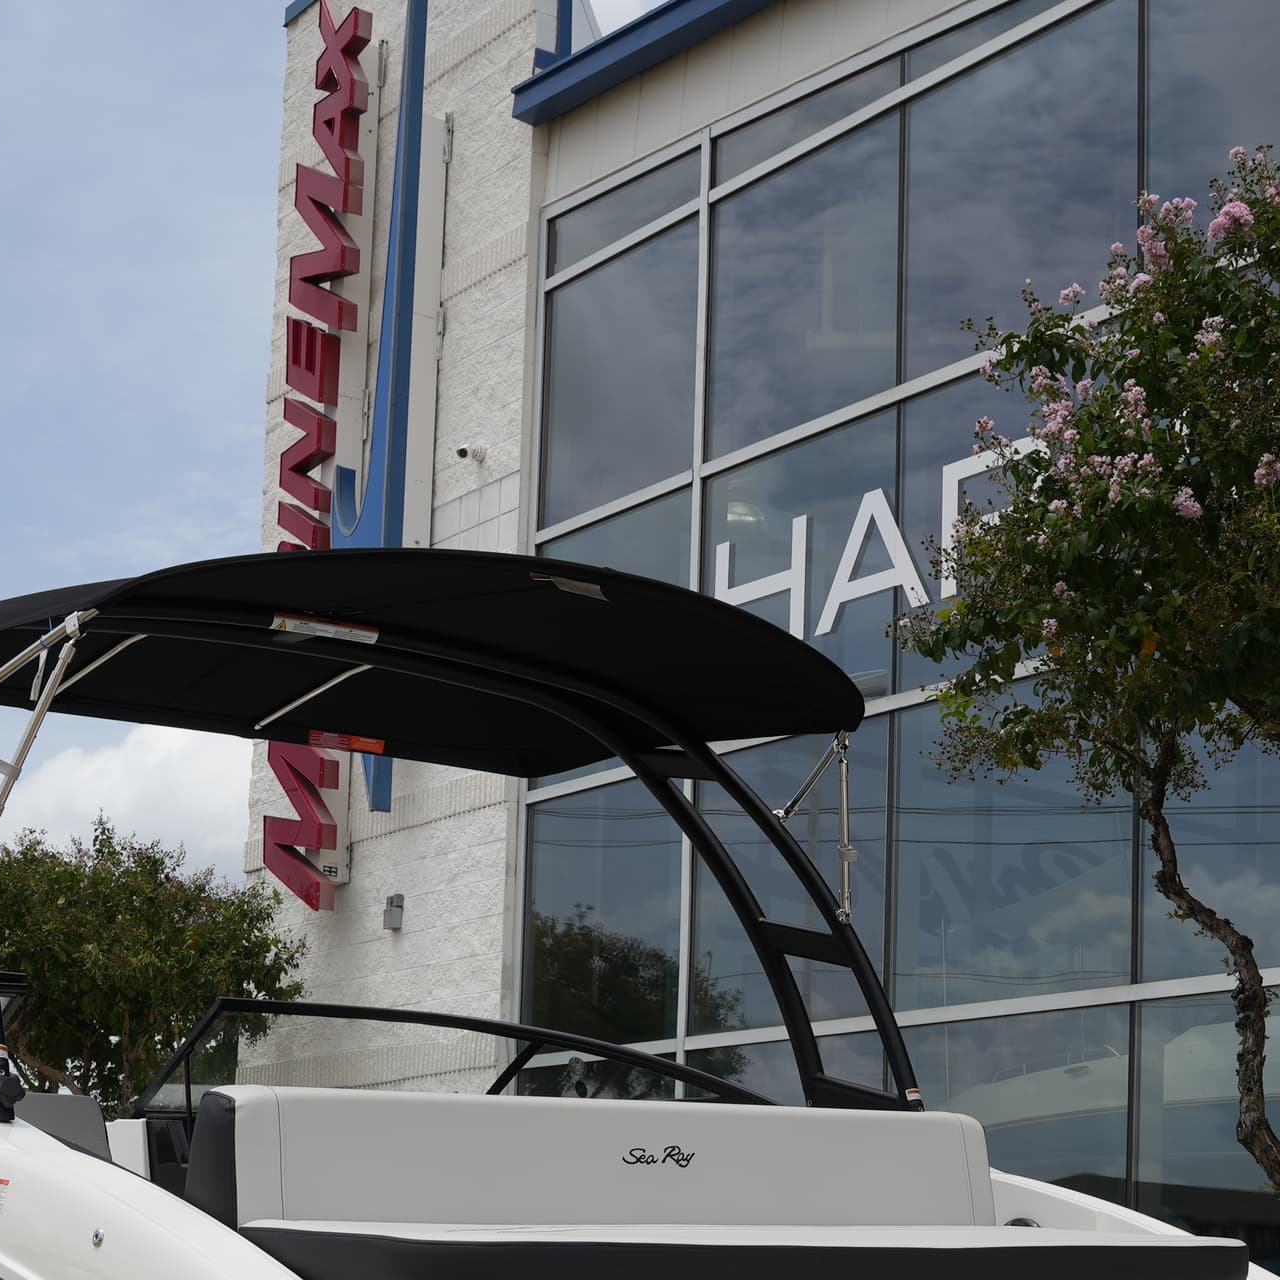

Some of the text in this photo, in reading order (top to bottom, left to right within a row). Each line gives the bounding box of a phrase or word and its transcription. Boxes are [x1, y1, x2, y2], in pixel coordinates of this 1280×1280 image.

[263, 0, 373, 911] MINEMAX
[622, 1145, 695, 1168] Sea Ray
